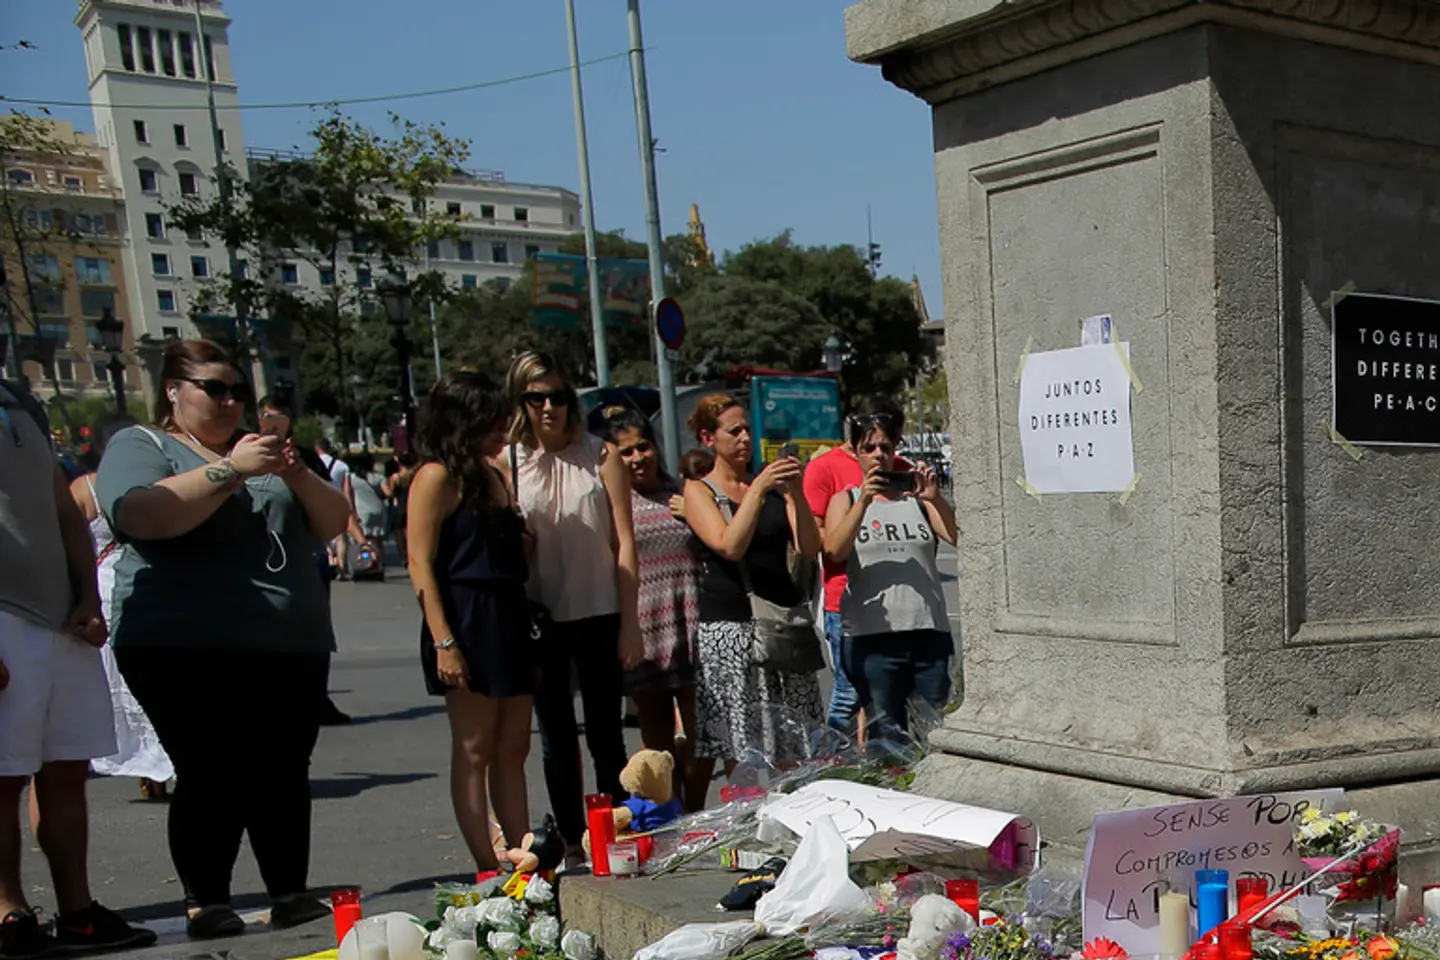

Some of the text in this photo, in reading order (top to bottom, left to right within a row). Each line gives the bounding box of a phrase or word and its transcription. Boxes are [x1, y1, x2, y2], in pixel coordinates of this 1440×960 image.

[1045, 378, 1102, 399] JUNTOS
[1031, 409, 1118, 430] DIFERENTES
[1143, 803, 1231, 837] SENSE
[1105, 890, 1140, 920] LA
